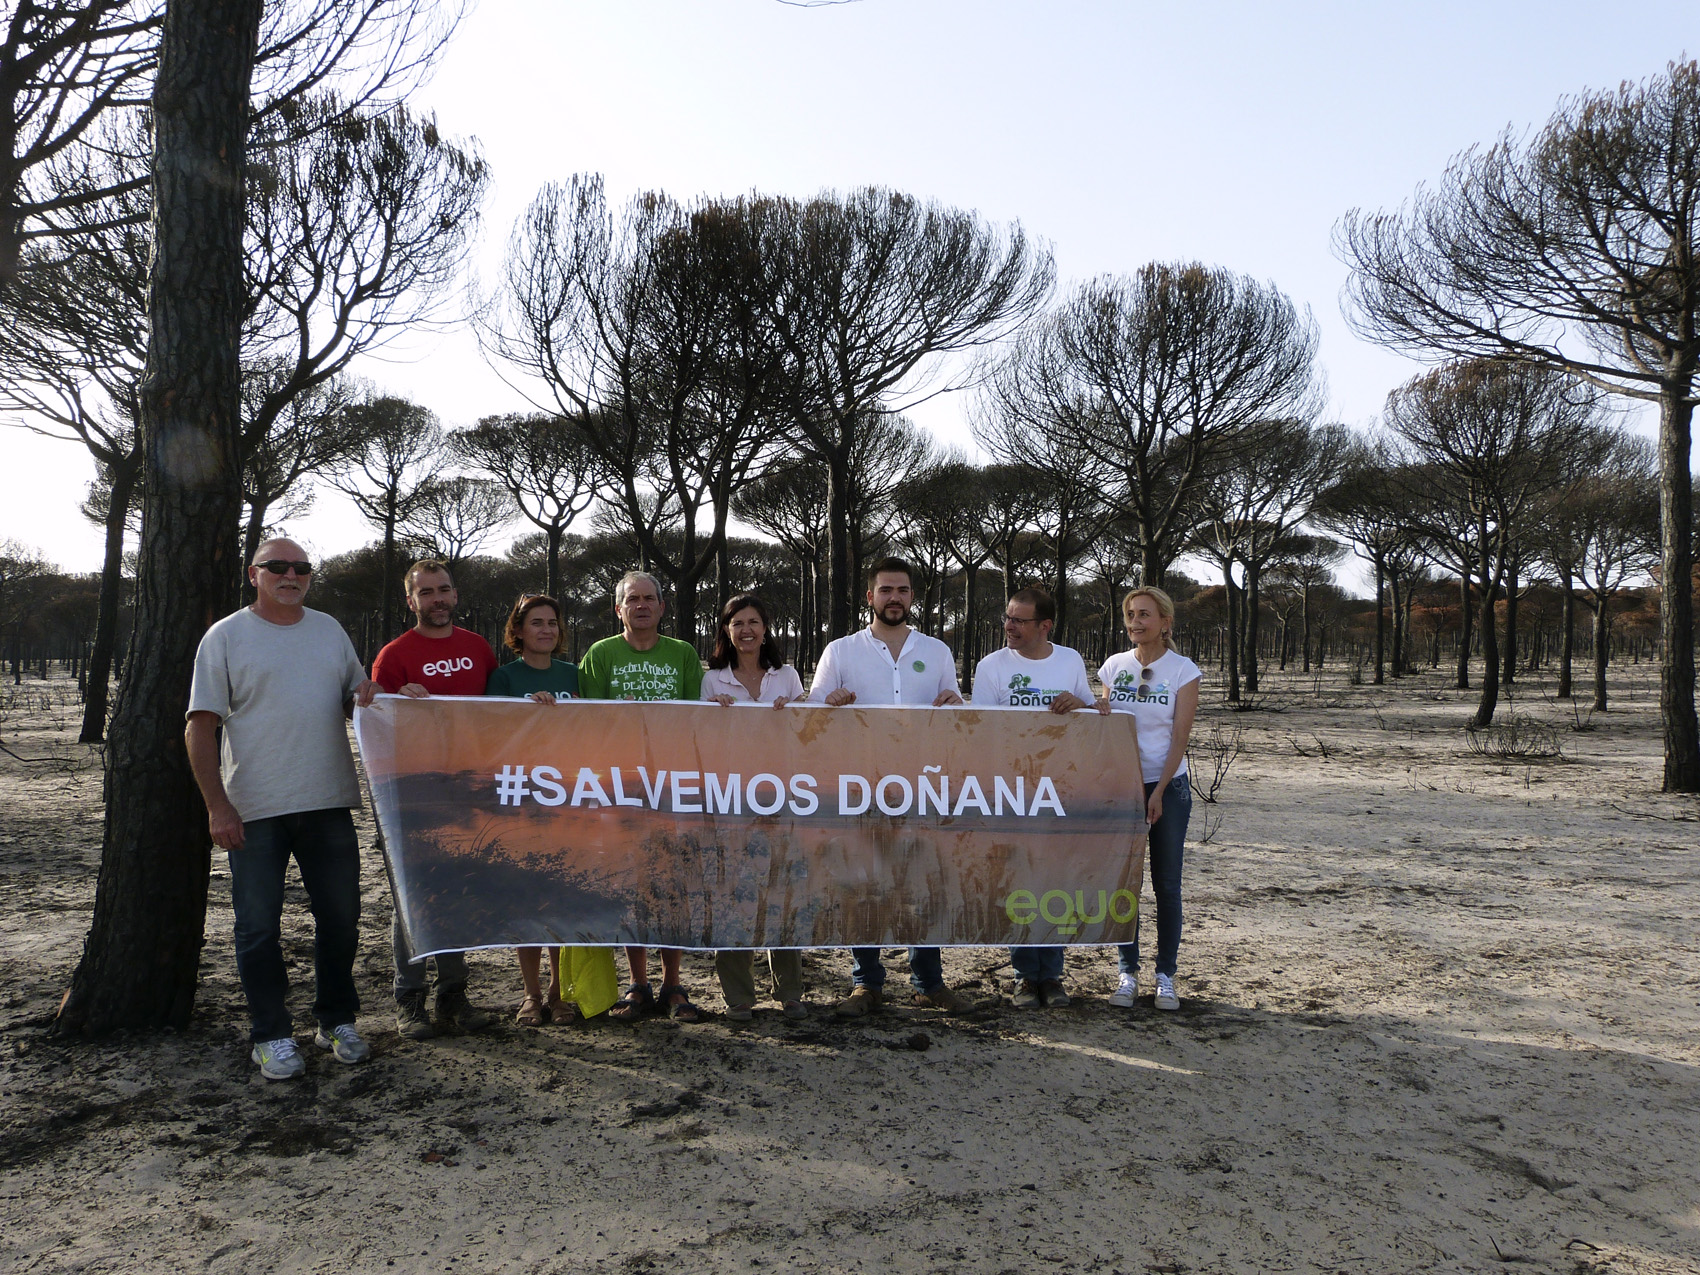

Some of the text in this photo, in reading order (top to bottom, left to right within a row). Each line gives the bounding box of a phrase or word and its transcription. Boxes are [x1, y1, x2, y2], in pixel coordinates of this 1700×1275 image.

[423, 656, 473, 677] equo
[623, 681, 638, 691] DE
[1010, 694, 1057, 706] Doña
[495, 764, 1067, 818] #SALVEMOS DOÑANA
[1005, 887, 1138, 935] equo
